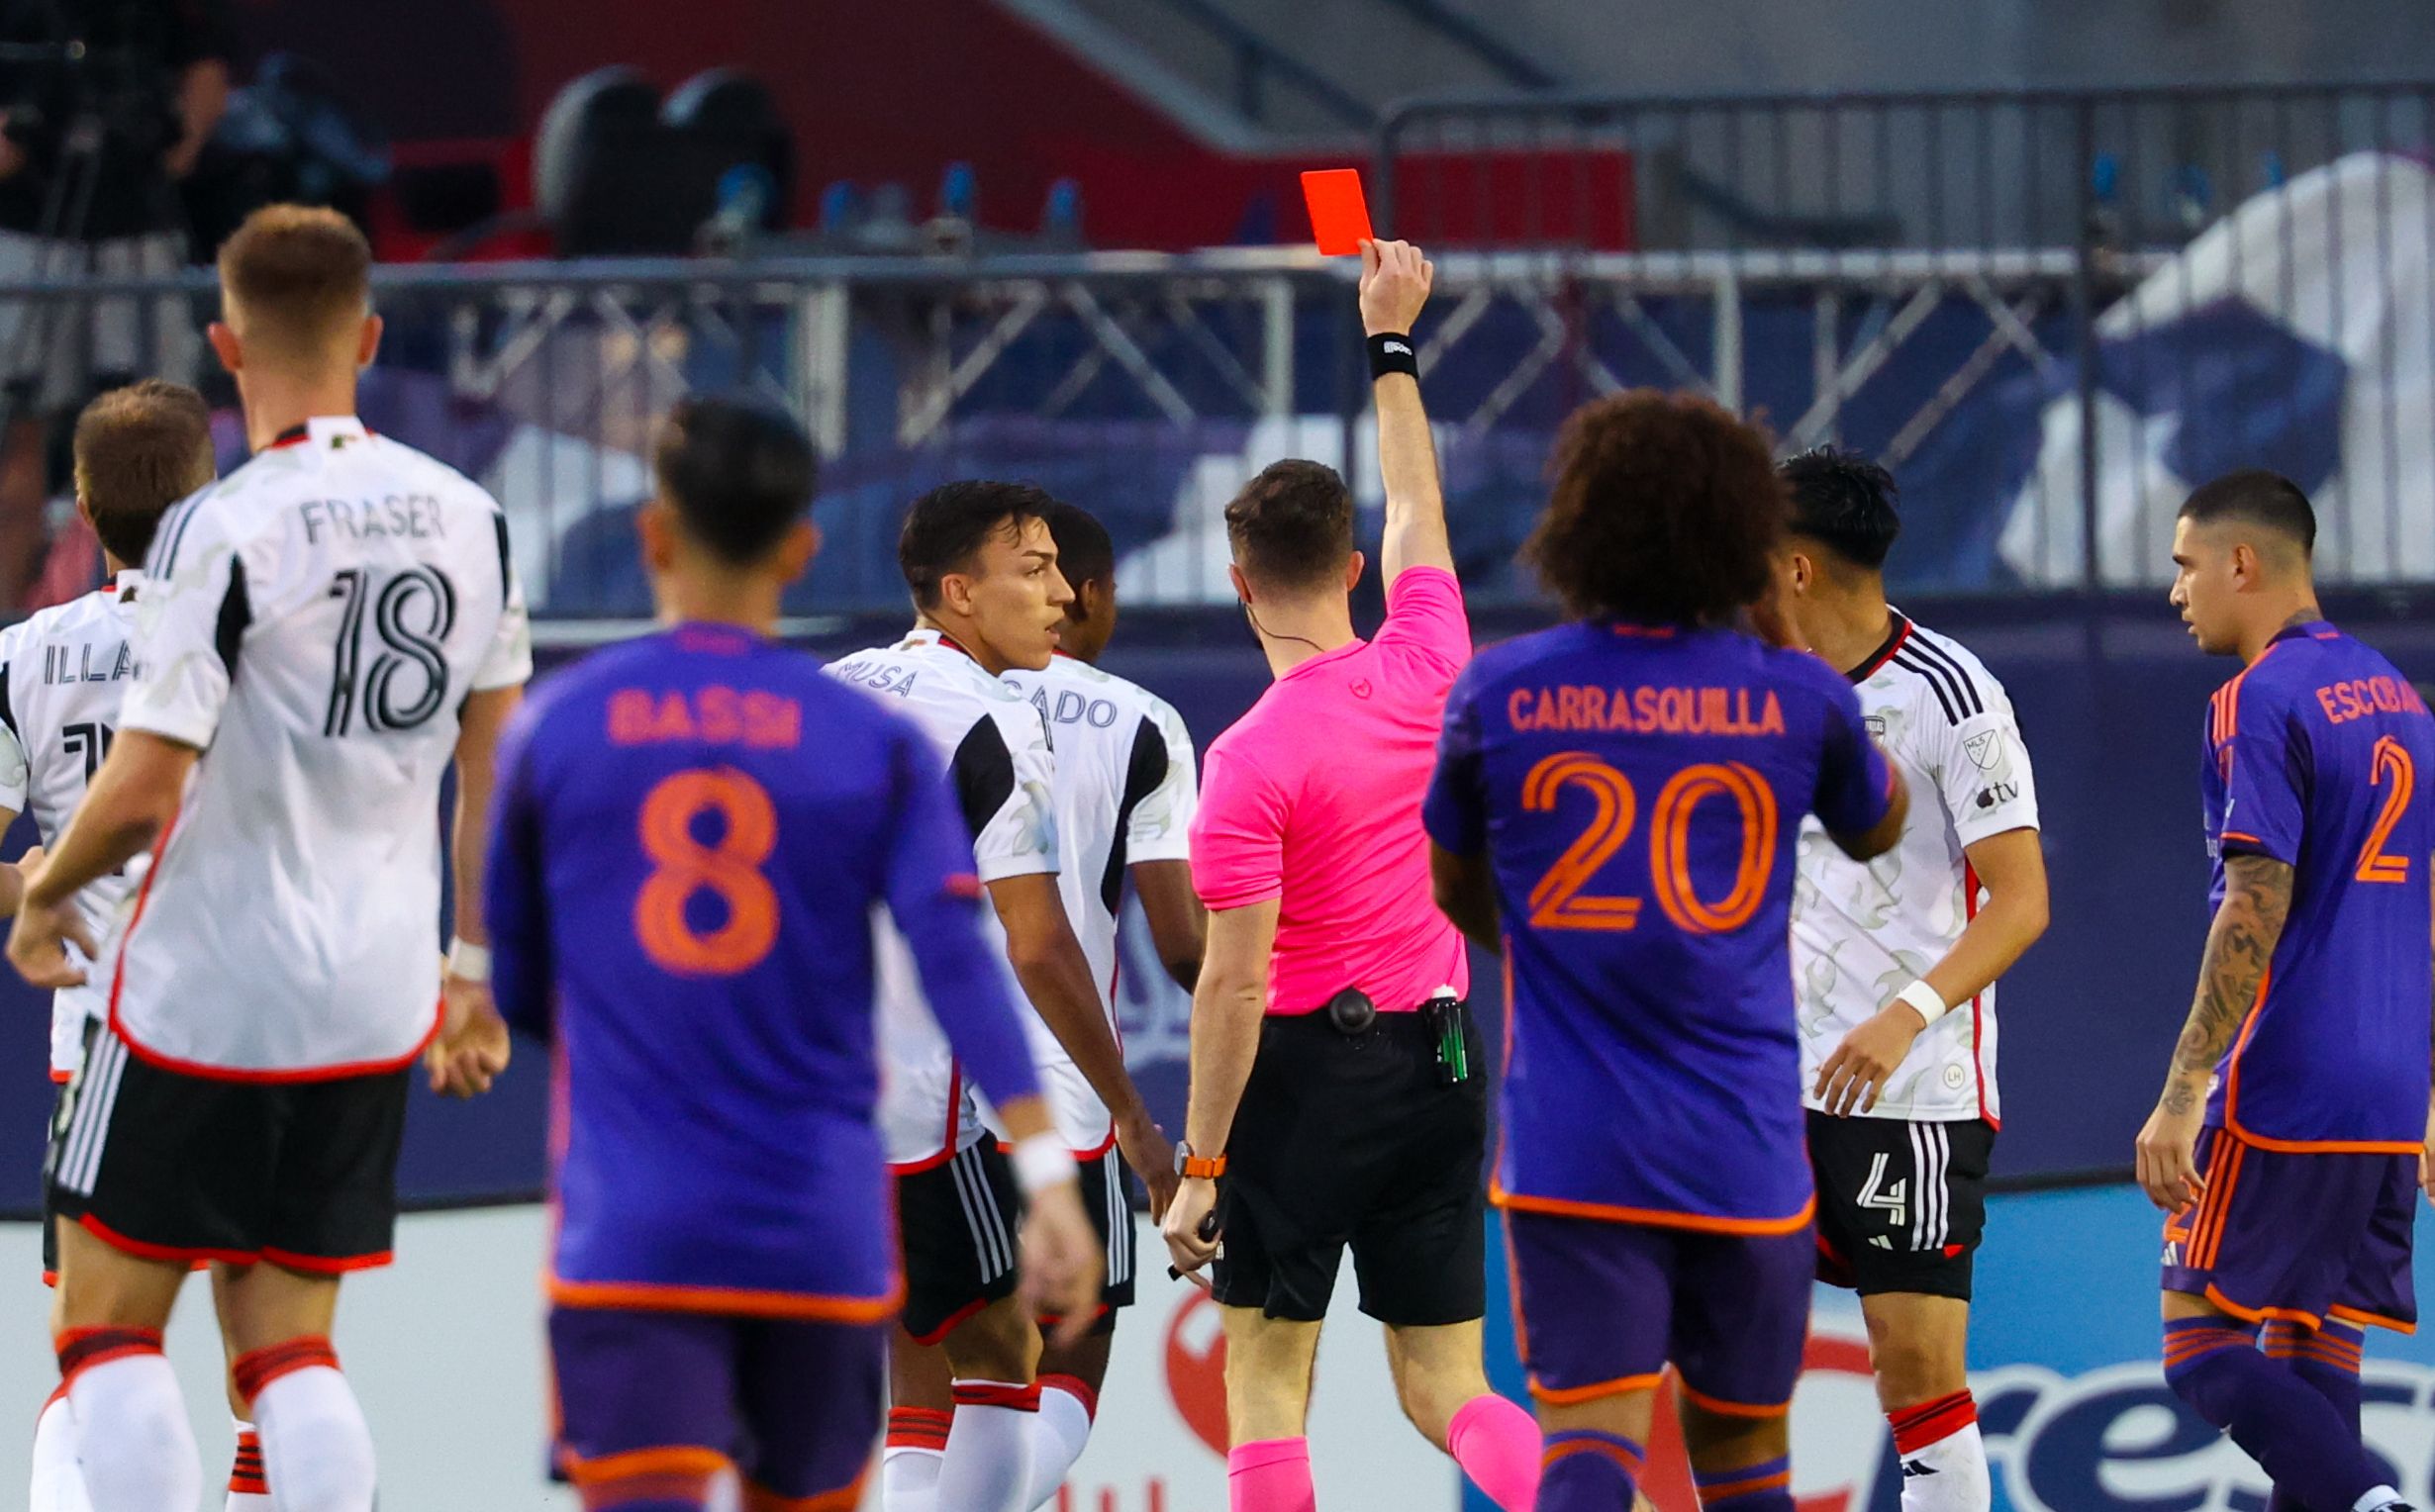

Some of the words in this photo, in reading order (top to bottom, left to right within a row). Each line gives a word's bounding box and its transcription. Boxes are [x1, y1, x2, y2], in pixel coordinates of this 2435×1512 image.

[299, 494, 446, 545] FRASER
[45, 639, 140, 685] ILLA
[324, 562, 457, 737] 18
[1508, 684, 1786, 735] CARRASQUILLA
[1967, 735, 1986, 749] MLS
[2355, 734, 2414, 884] 2
[632, 765, 782, 977] 8
[1521, 749, 1779, 935] 20
[1947, 1071, 1961, 1083] LH
[1855, 1152, 1906, 1226] 4
